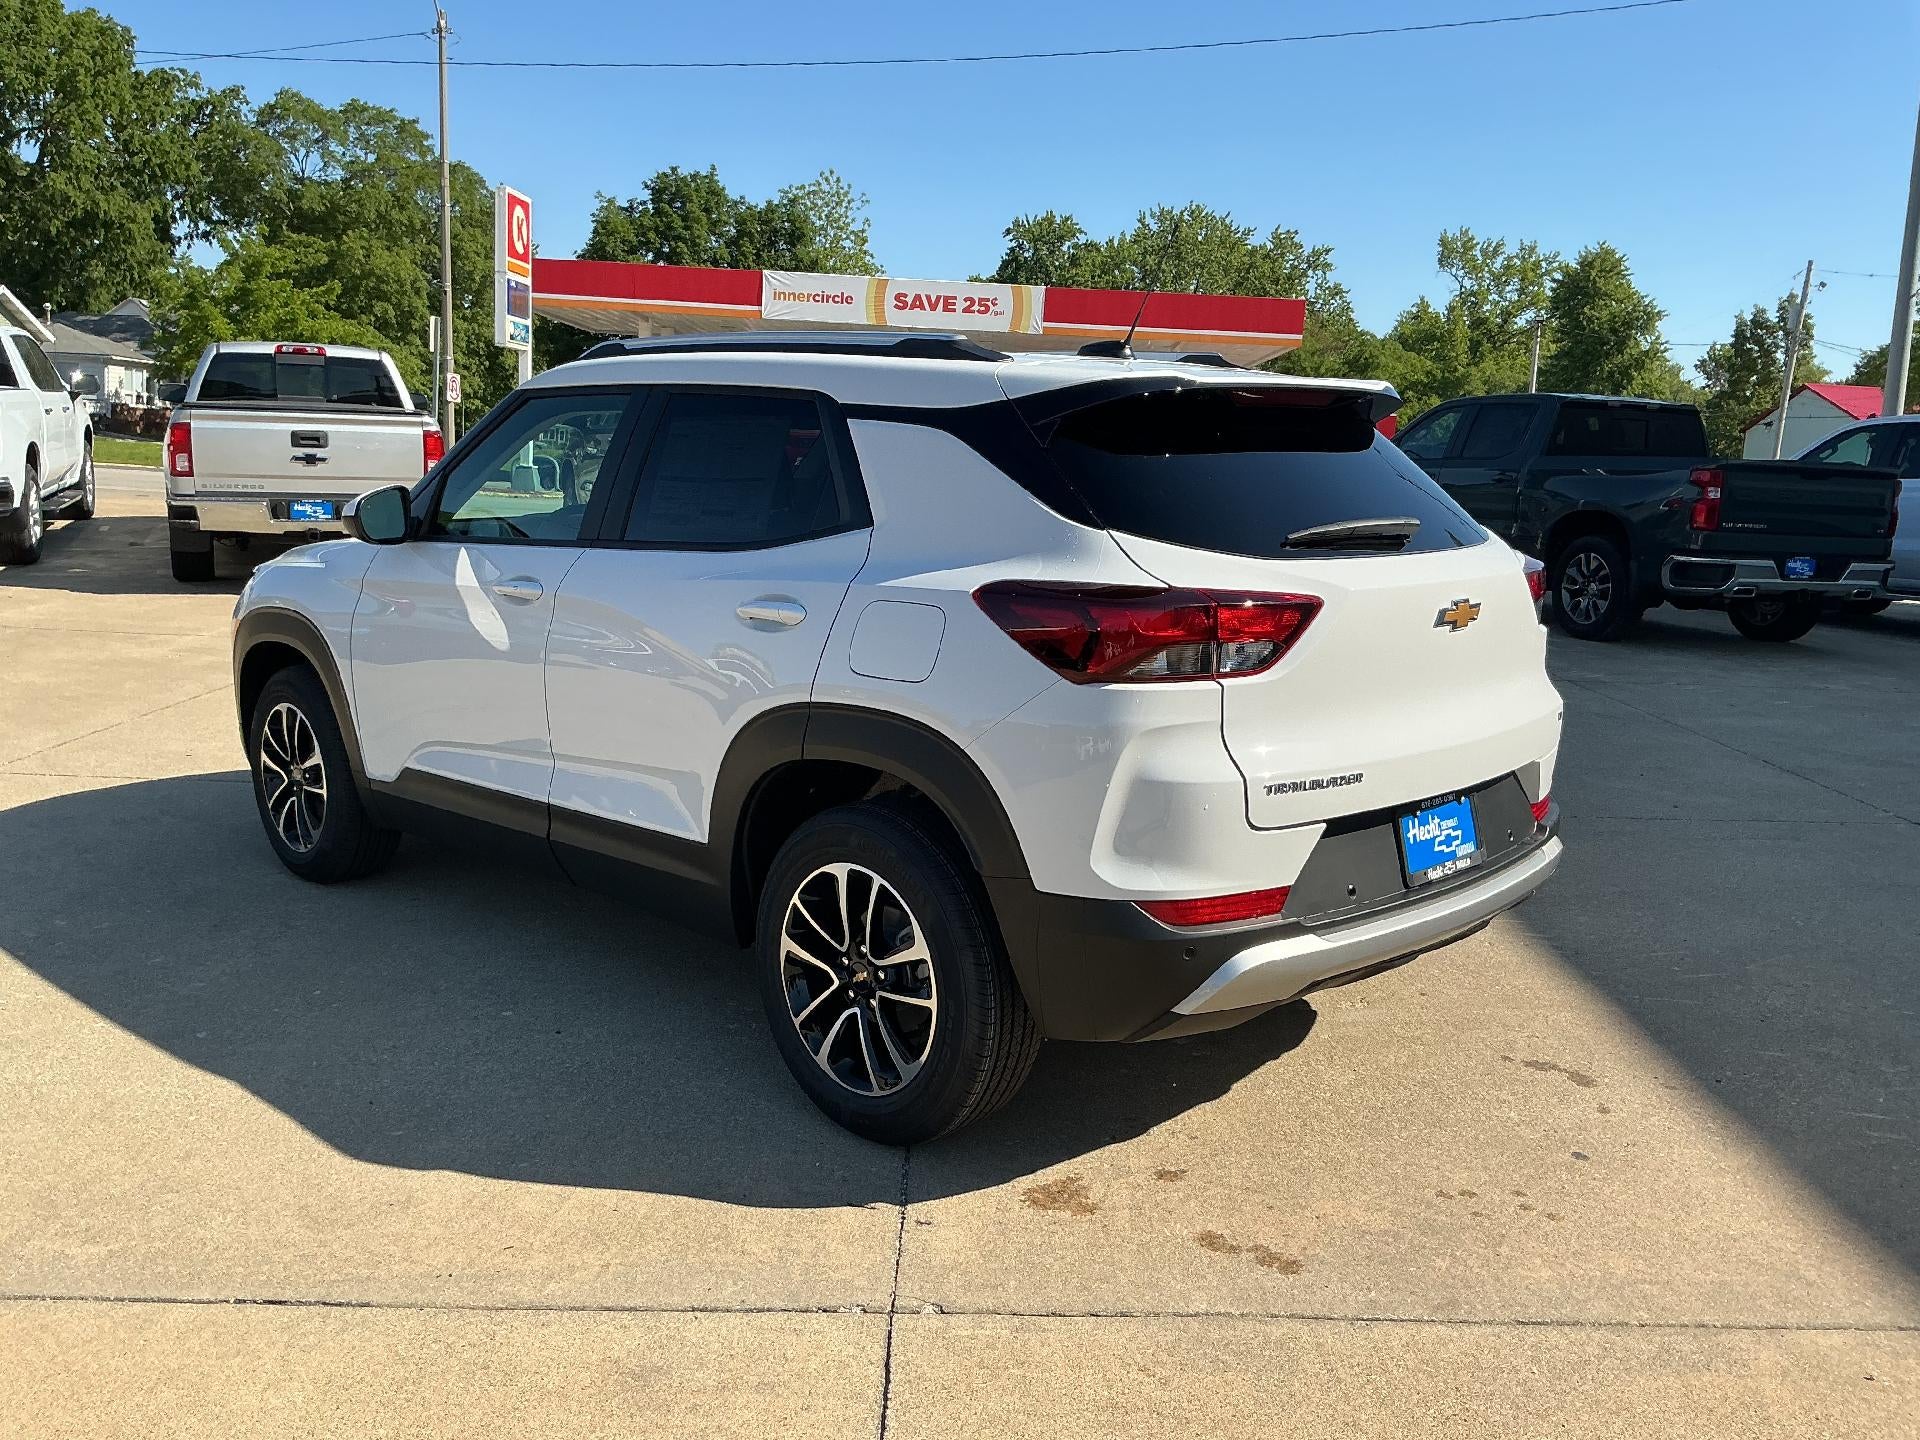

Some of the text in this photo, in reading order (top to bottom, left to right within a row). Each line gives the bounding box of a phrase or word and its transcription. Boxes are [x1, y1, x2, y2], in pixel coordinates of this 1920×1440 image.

[516, 215, 527, 249] K
[773, 288, 854, 305] innercircle
[893, 292, 958, 313] SAVE
[1263, 772, 1364, 796] TRAILBLAZER
[1407, 814, 1441, 845] Hecht
